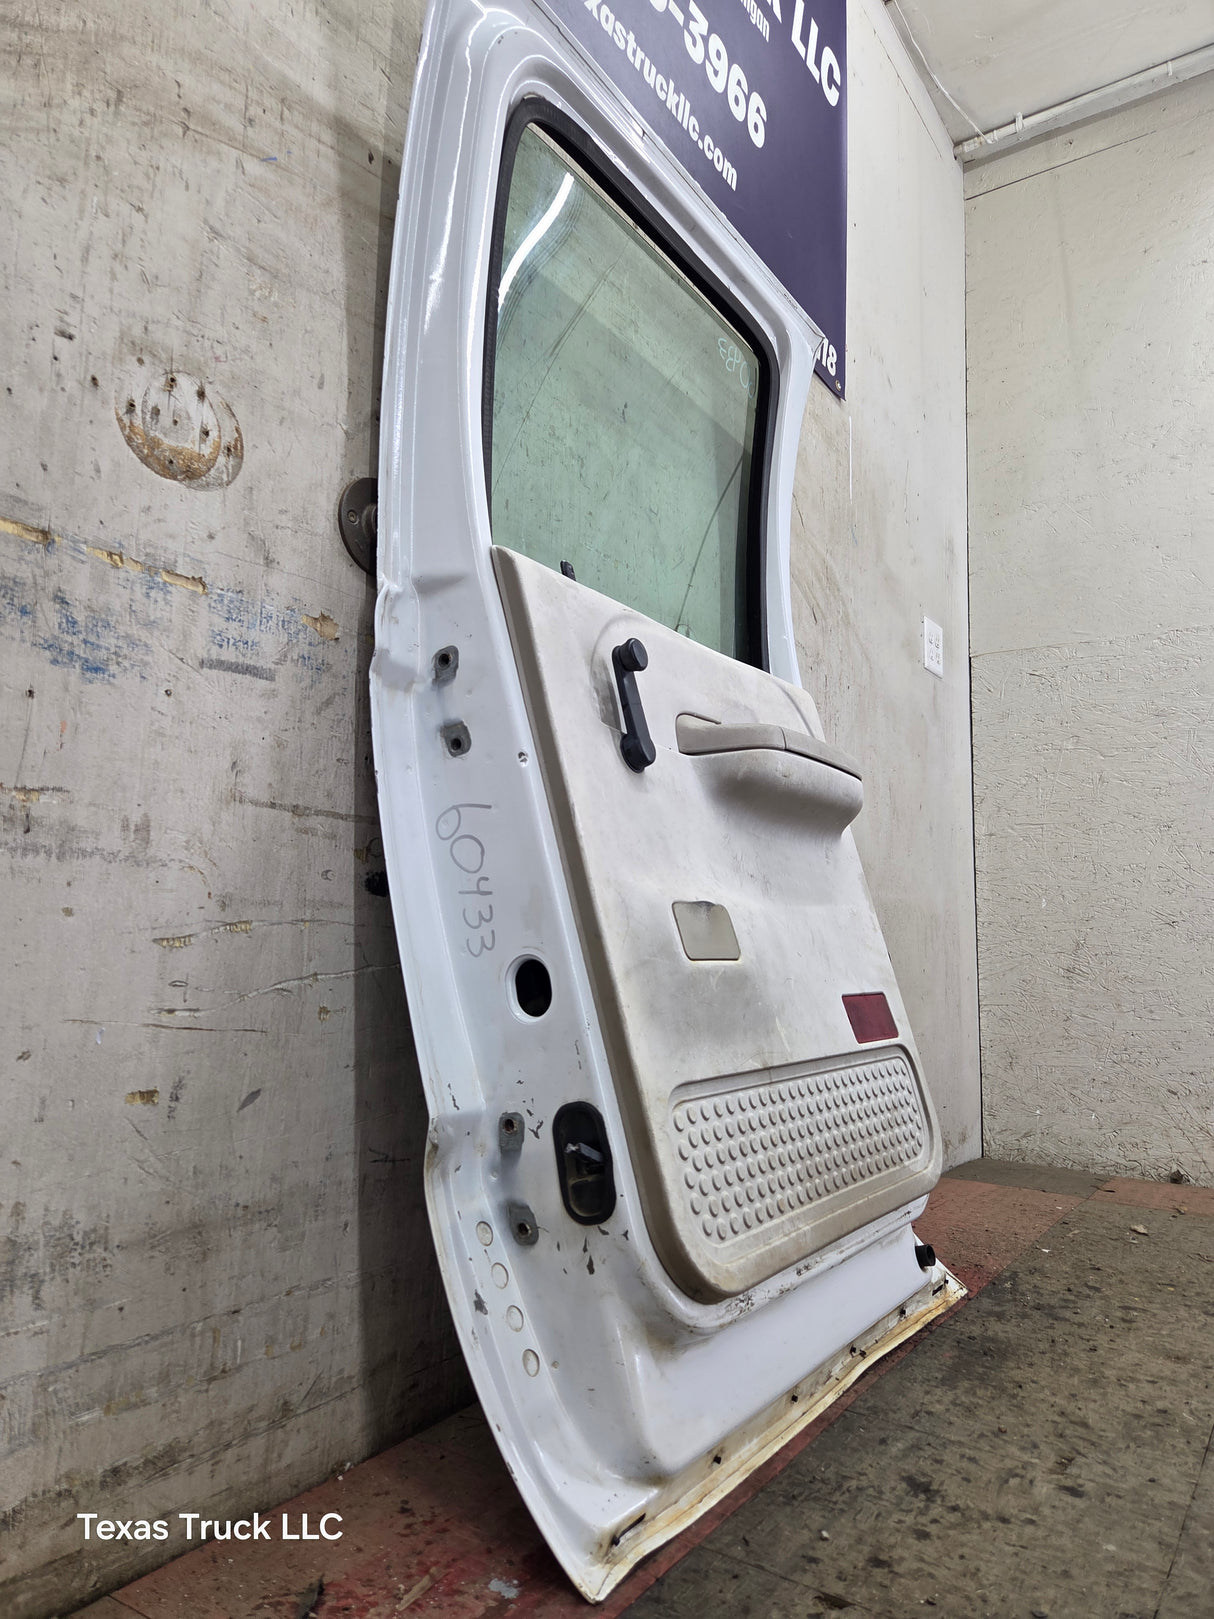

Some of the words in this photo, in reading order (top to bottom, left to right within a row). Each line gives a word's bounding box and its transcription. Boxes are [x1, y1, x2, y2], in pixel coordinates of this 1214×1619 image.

[648, 0, 767, 149] -3966
[791, 0, 841, 107] LLC
[815, 337, 837, 377] 18
[435, 803, 496, 958] 60433
